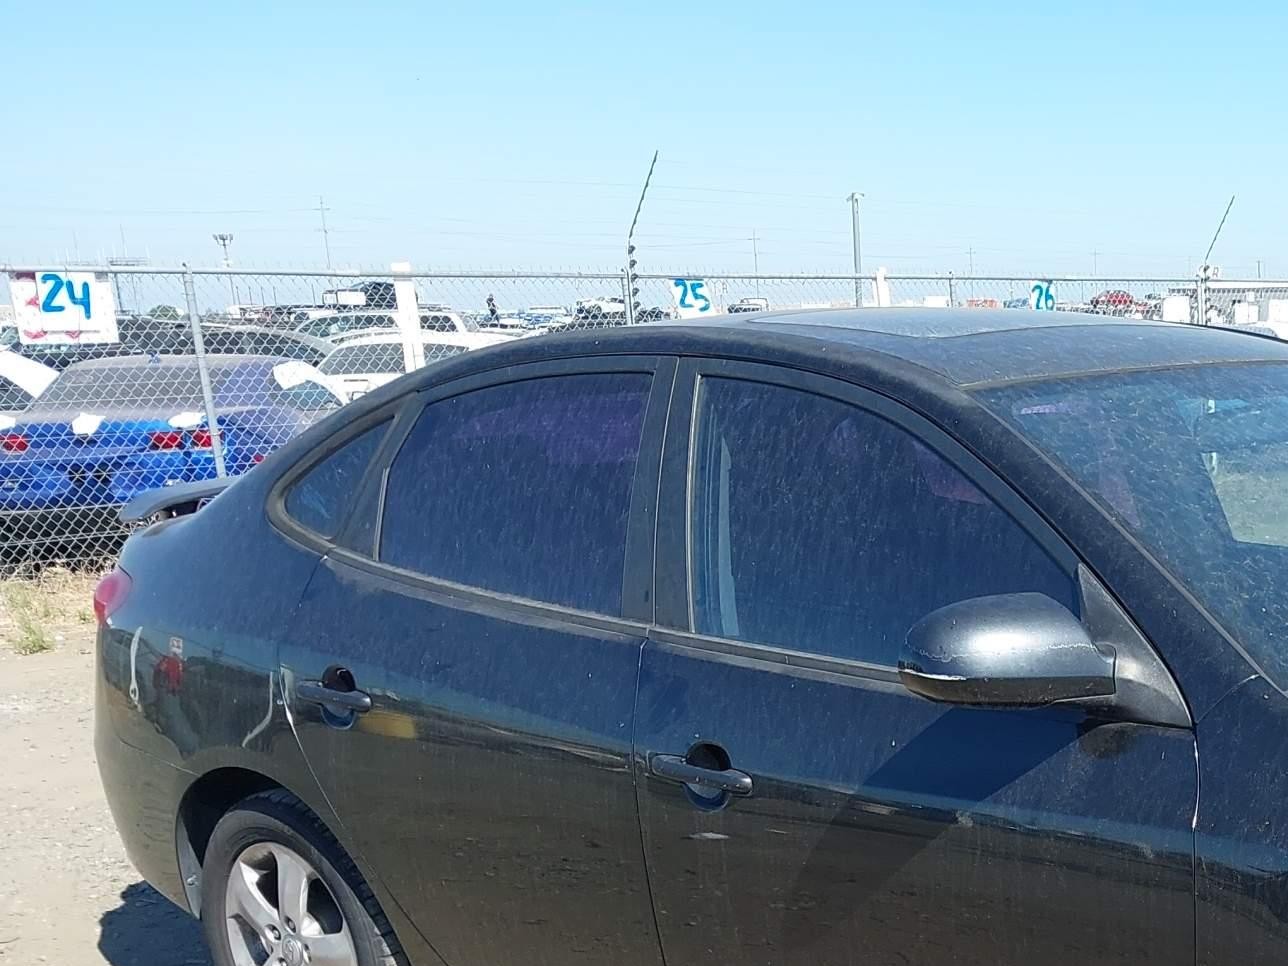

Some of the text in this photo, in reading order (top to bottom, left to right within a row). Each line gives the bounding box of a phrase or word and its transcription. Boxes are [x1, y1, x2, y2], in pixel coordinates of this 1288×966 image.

[40, 273, 92, 320] 24
[674, 278, 711, 312] 25
[1031, 282, 1056, 310] 26
